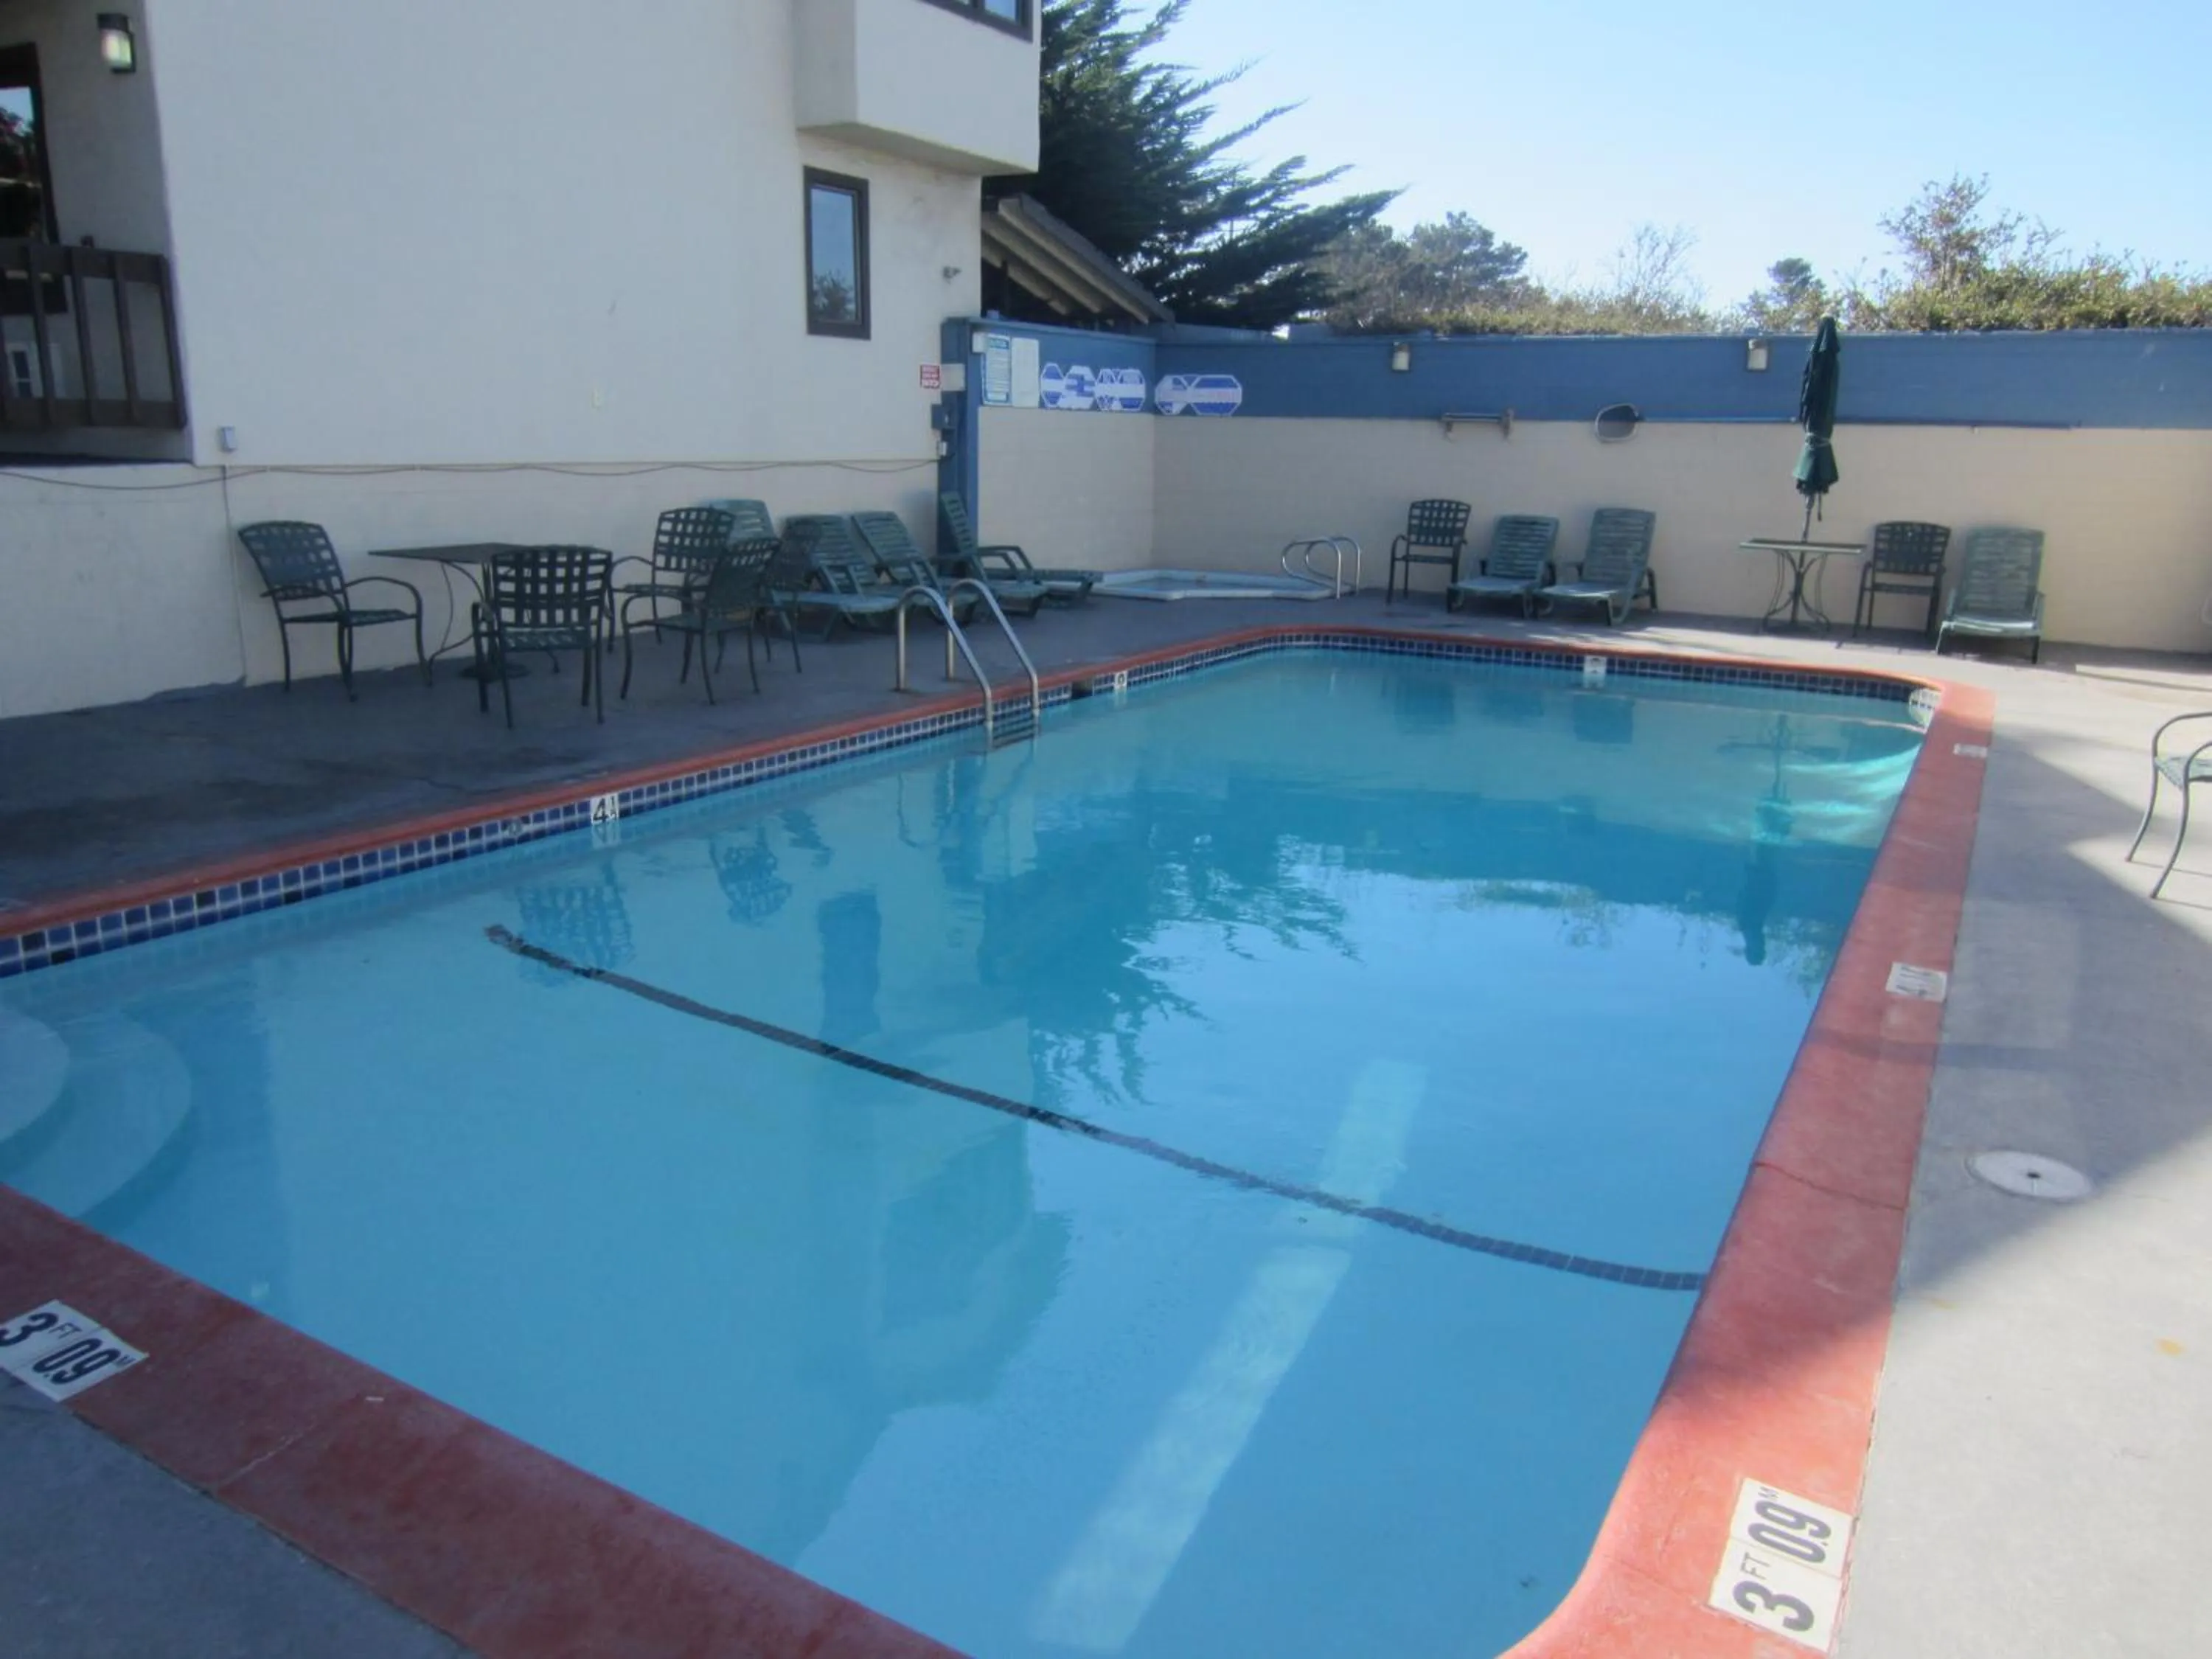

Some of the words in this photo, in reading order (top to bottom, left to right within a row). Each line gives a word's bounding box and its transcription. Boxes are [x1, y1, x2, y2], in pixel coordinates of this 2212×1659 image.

[0, 1312, 59, 1347] 3
[1741, 1552, 1770, 1580] FT
[1733, 1581, 1815, 1632] 3
